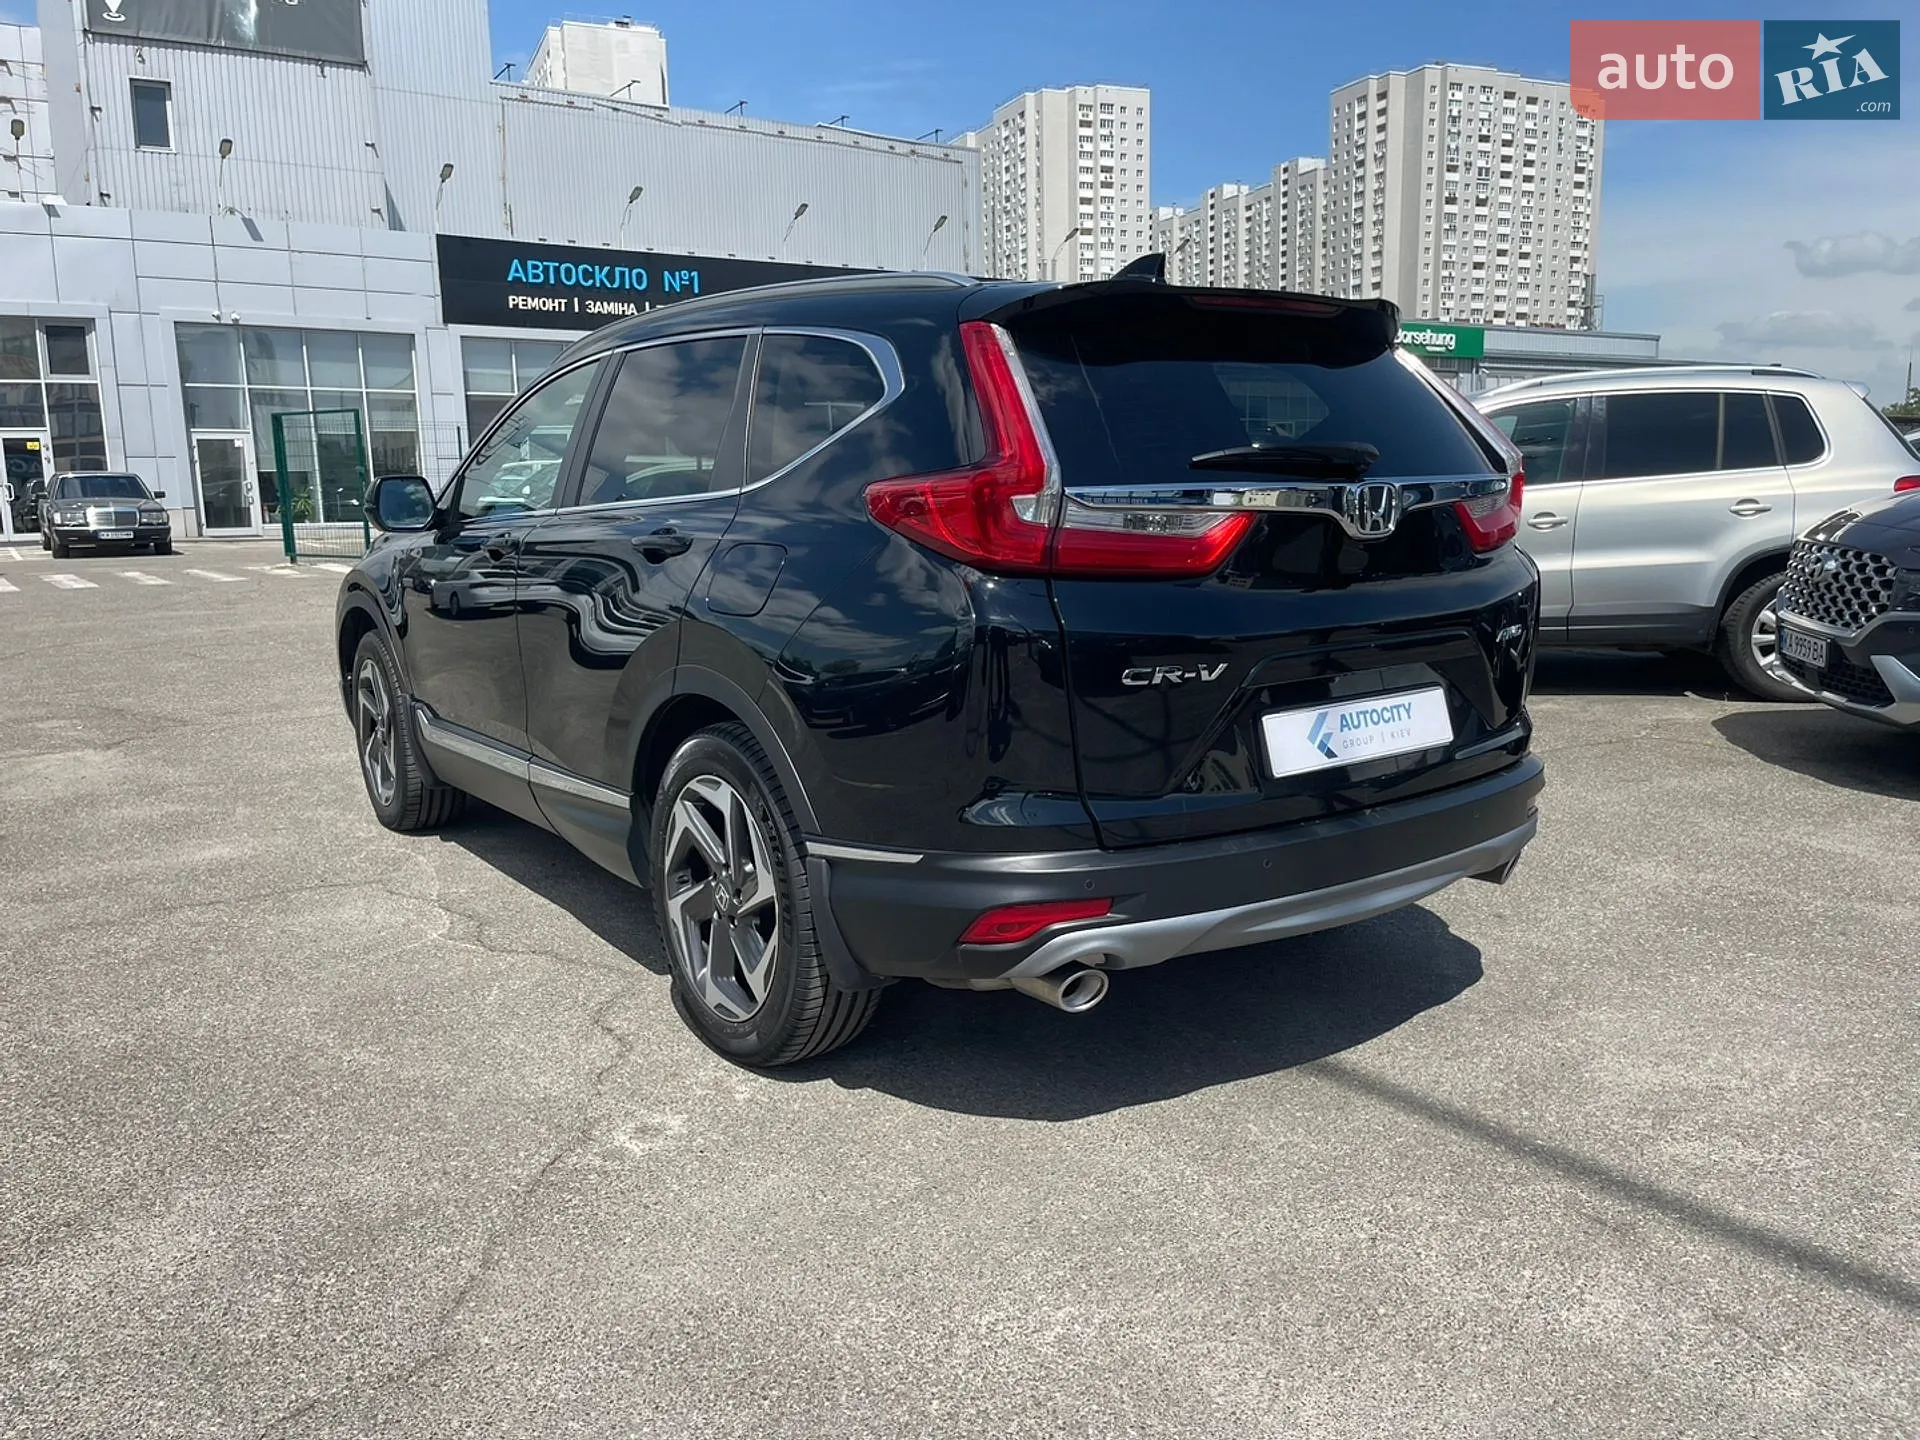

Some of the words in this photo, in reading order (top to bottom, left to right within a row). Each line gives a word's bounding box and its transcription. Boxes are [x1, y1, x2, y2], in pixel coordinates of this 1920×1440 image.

[507, 258, 648, 291] АВТОСКЛО
[663, 270, 700, 294] №1
[508, 295, 568, 313] РЕМОНТ
[585, 300, 639, 316] ЗАМІНА
[1121, 663, 1229, 685] CR-V
[1340, 702, 1412, 733] AUTOCITY
[1342, 735, 1375, 749] GROUP
[1391, 728, 1411, 740] KIEV
